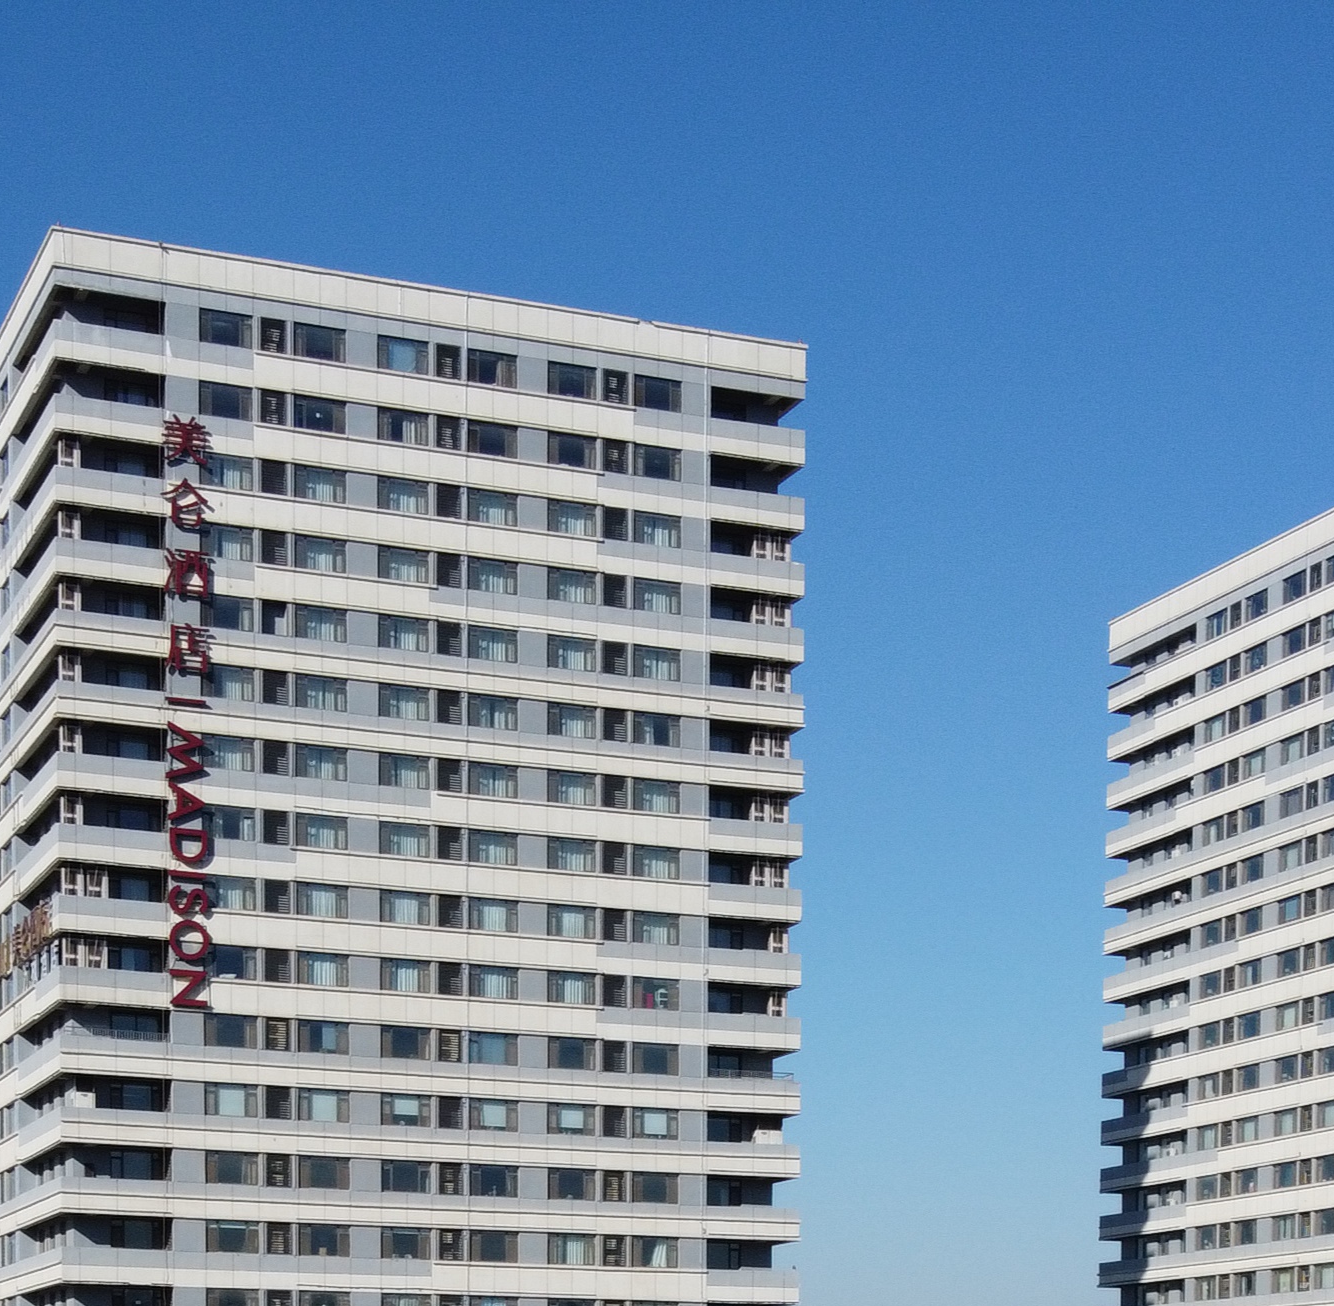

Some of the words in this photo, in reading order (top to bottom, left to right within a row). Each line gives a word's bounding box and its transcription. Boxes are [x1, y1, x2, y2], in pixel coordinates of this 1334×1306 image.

[161, 414, 209, 673] 美仑酒店
[165, 720, 209, 1008] MADISON
